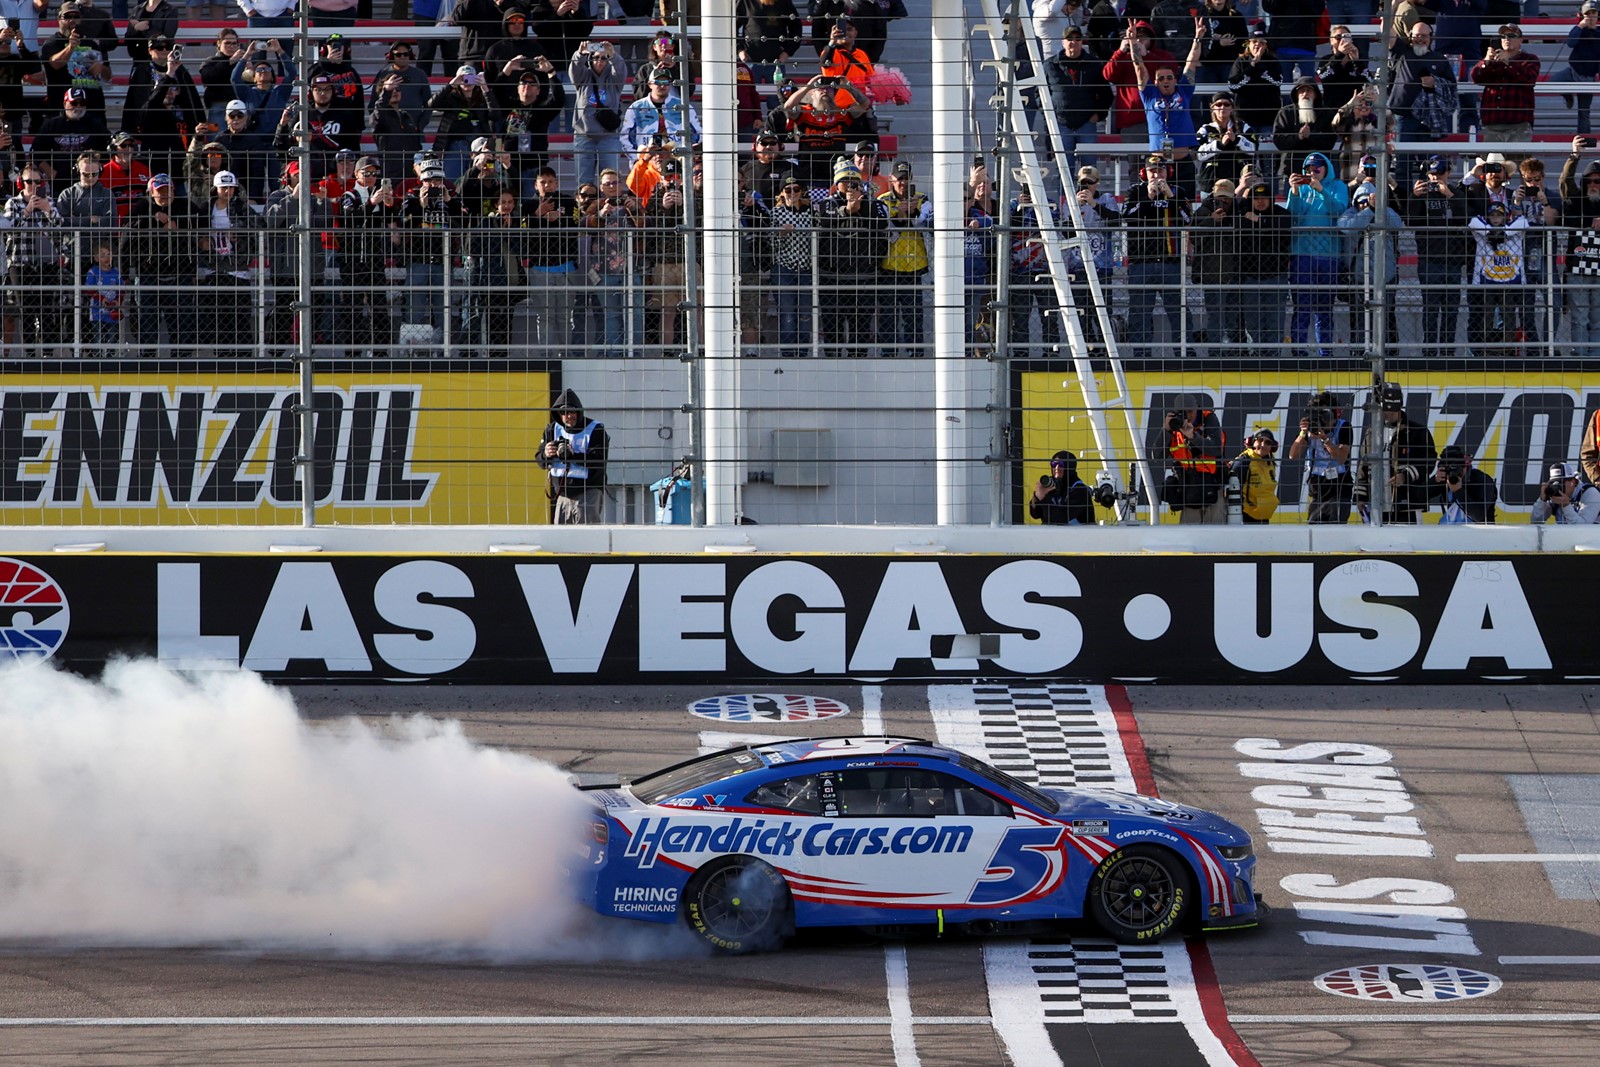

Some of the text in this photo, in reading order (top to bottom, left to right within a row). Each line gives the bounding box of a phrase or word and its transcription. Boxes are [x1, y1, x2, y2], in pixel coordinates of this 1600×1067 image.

[323, 122, 341, 135] 20
[1493, 256, 1511, 266] NAPA
[1463, 561, 1503, 582] FJB
[157, 560, 1554, 674] LAS VEGAS USA
[1115, 828, 1179, 843] GOODYEAR
[1232, 737, 1482, 956] LAS VEGAS
[594, 850, 605, 865] 5
[1097, 850, 1125, 879] EAGLE
[966, 825, 1068, 909] 5
[1233, 862, 1242, 877] 5
[614, 887, 678, 902] HIRING
[613, 903, 677, 912] TECHNICIANS
[1136, 887, 1184, 940] GOODYEAR
